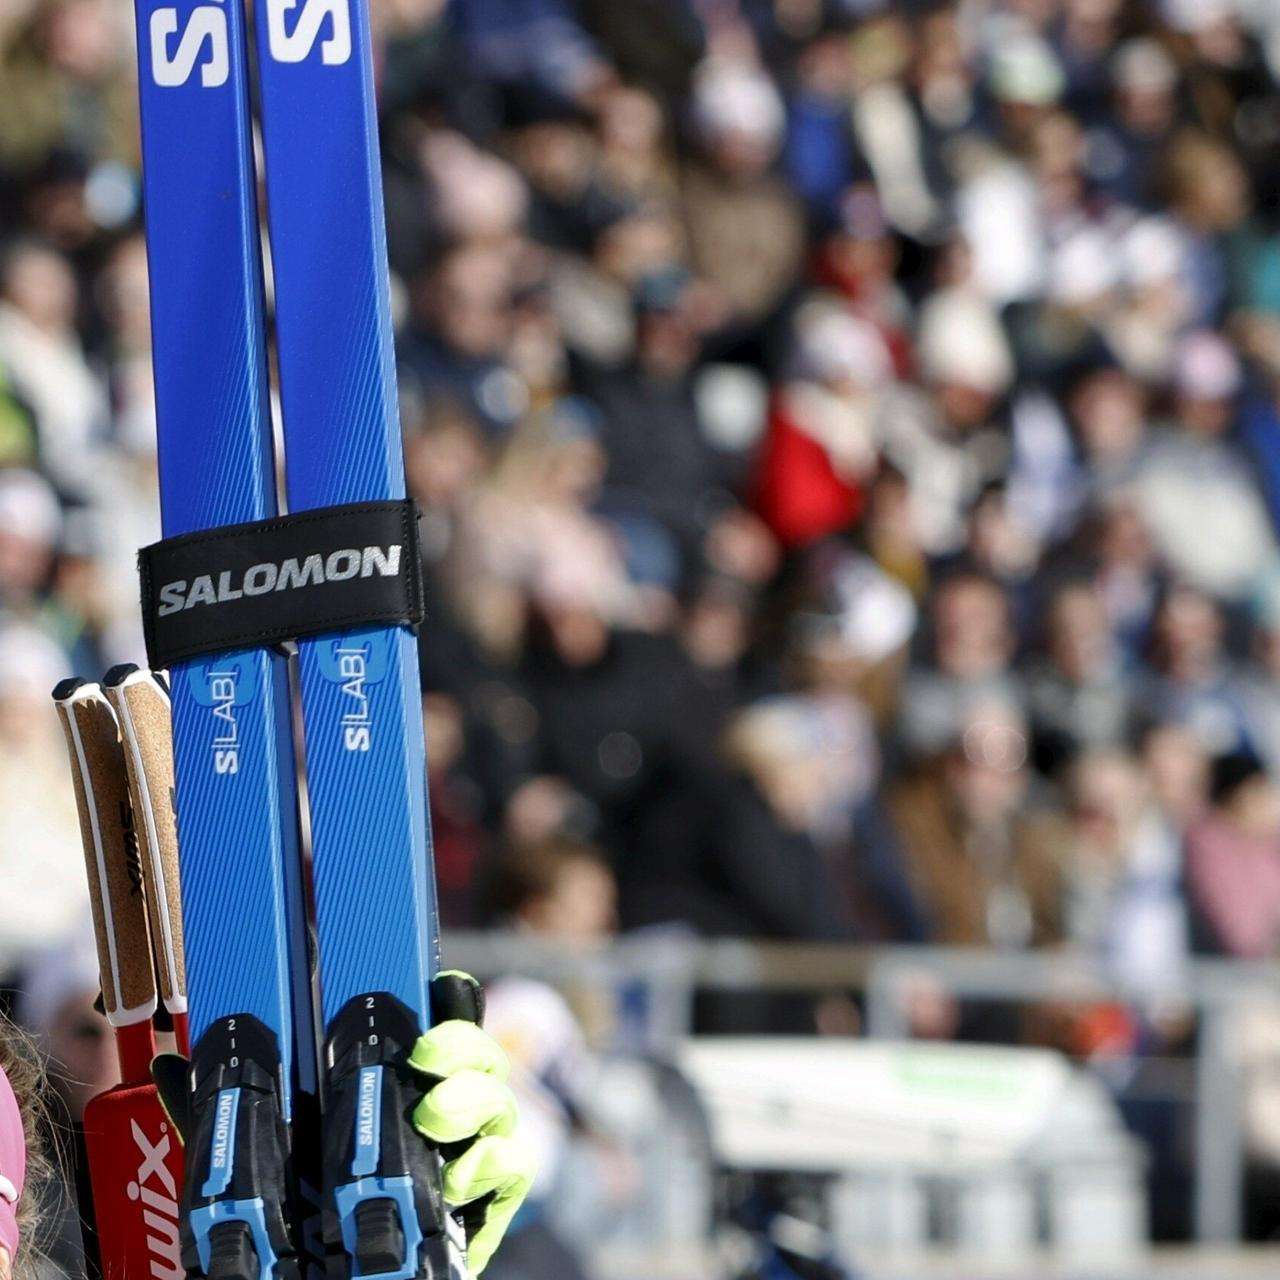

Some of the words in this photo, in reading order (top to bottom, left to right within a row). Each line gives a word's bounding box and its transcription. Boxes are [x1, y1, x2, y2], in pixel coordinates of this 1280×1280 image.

[158, 544, 403, 618] SALOMON
[212, 1093, 233, 1169] SALOMON
[360, 1072, 376, 1146] SALOMON
